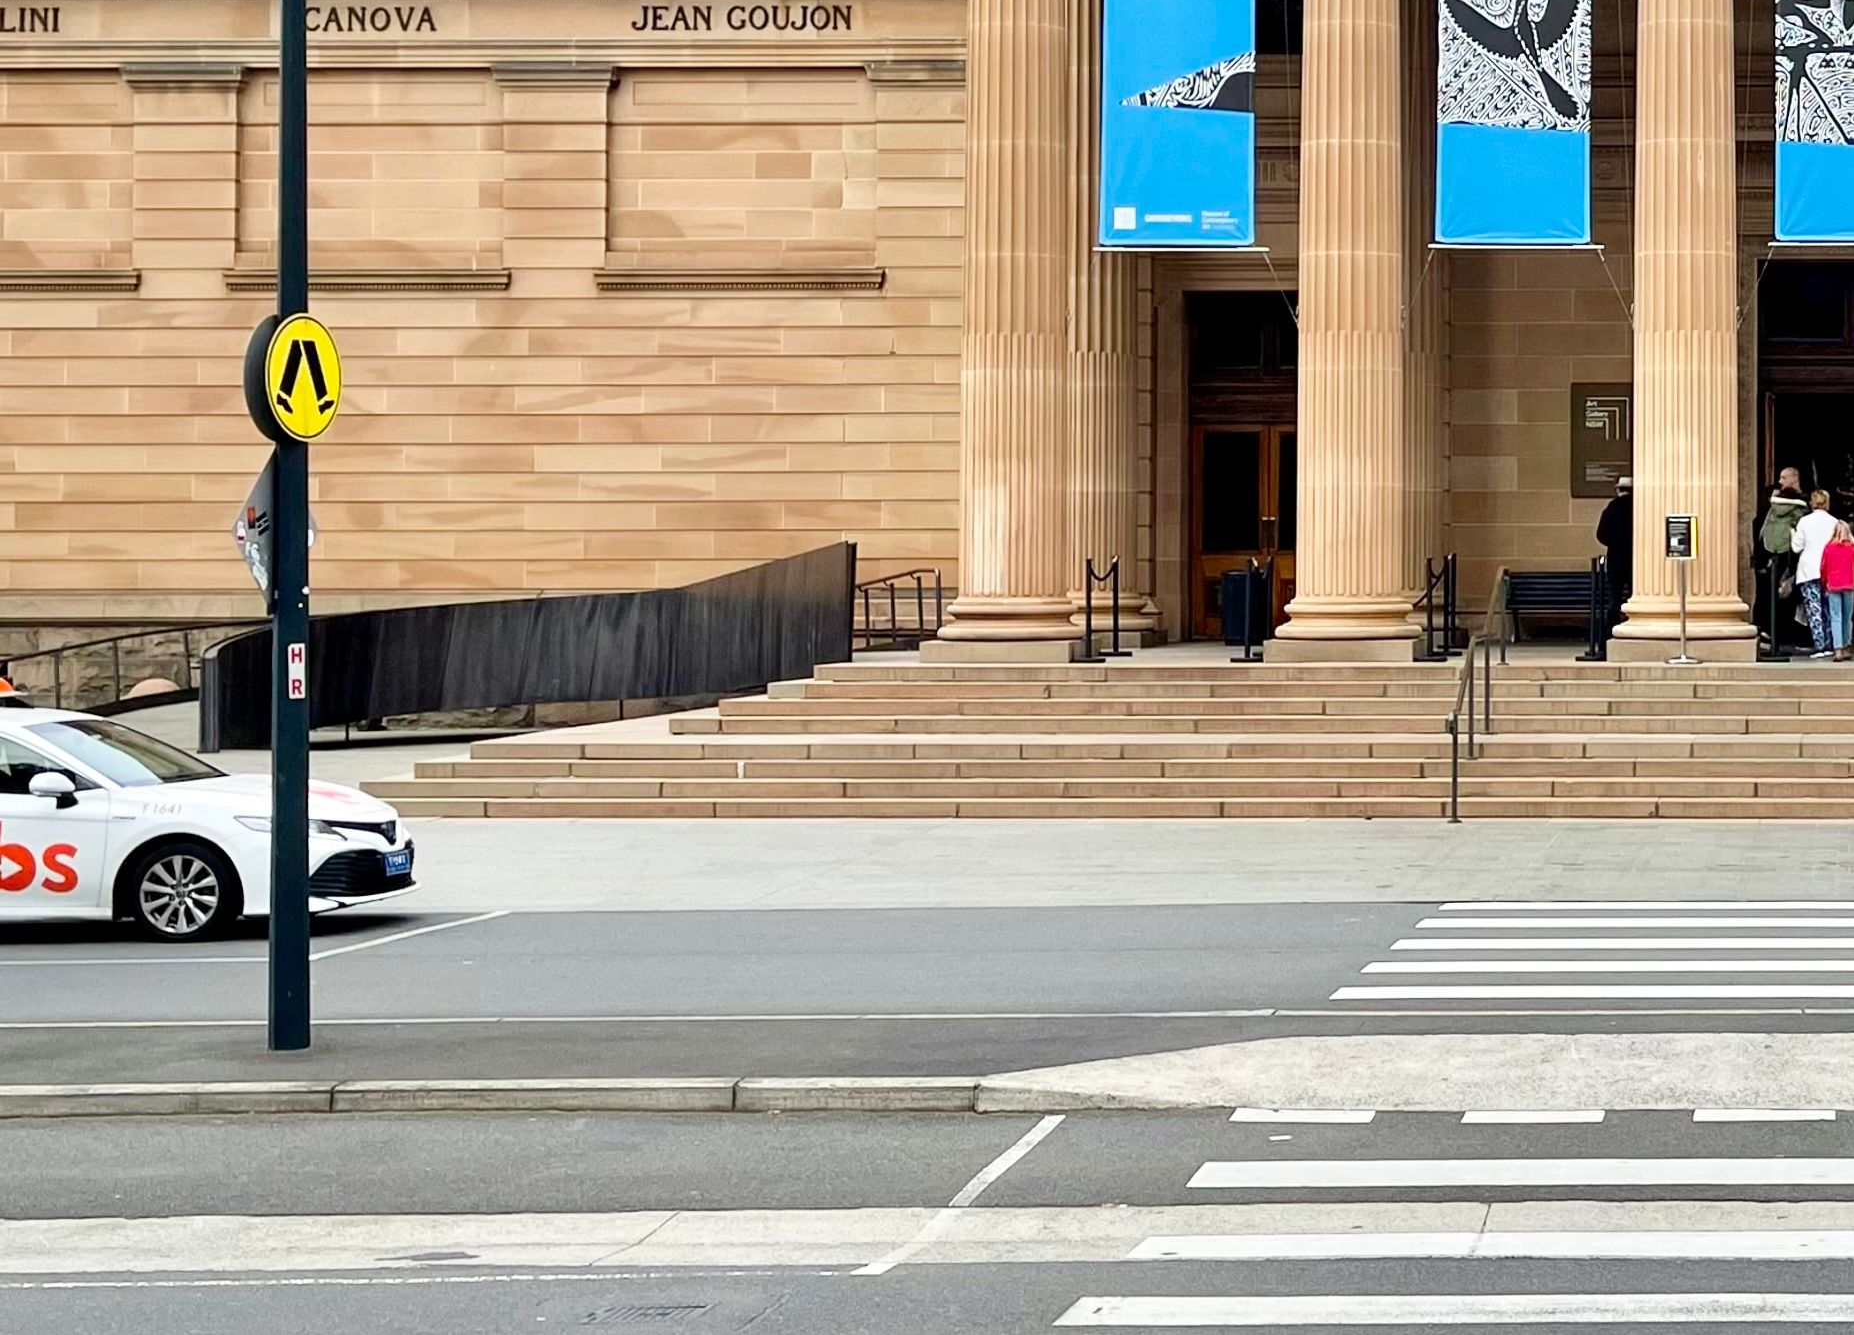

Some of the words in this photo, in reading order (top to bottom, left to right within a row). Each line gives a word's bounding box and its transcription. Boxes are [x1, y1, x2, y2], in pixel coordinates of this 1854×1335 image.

[306, 6, 438, 33] CANOVA
[631, 5, 713, 31] JEAN
[726, 4, 853, 31] GOUJON
